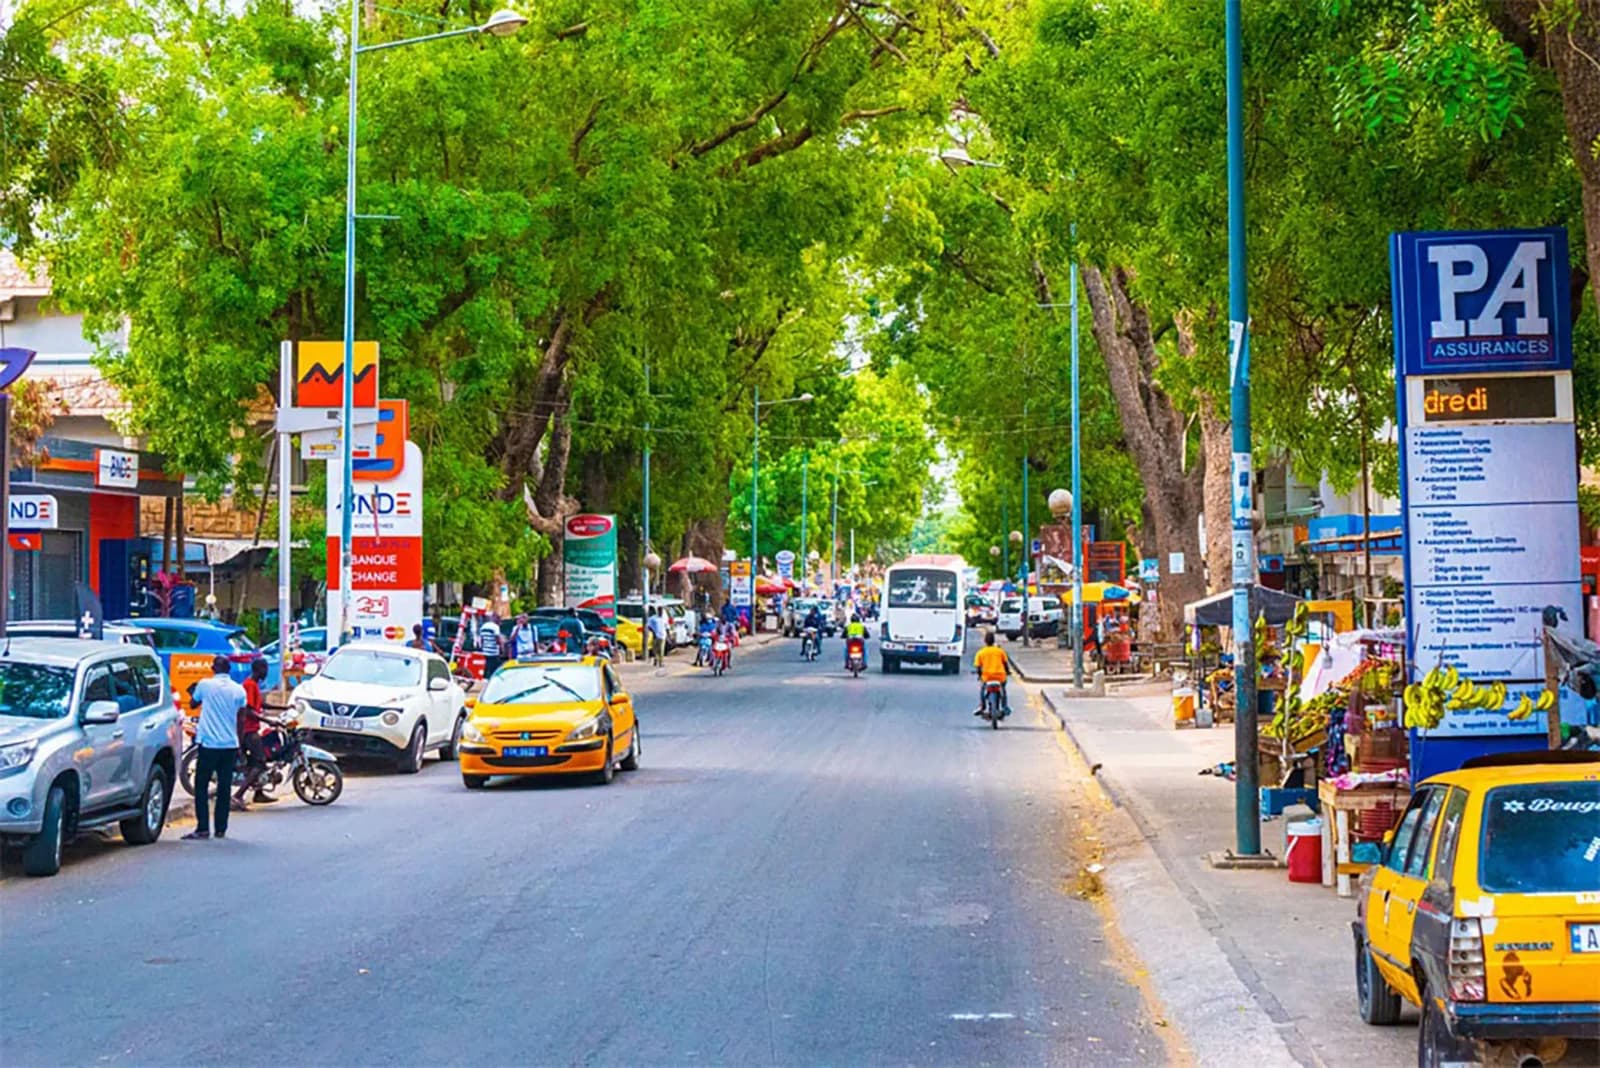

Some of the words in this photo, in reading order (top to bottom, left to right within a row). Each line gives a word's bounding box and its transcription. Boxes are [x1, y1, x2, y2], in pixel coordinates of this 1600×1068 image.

[1428, 241, 1548, 338] PA
[1434, 340, 1549, 356] ASSURANCES
[1424, 388, 1488, 414] dredi
[10, 501, 50, 519] NDE
[350, 554, 397, 566] BANQUE
[352, 572, 397, 583] CHANGE
[1588, 928, 1599, 949] A
